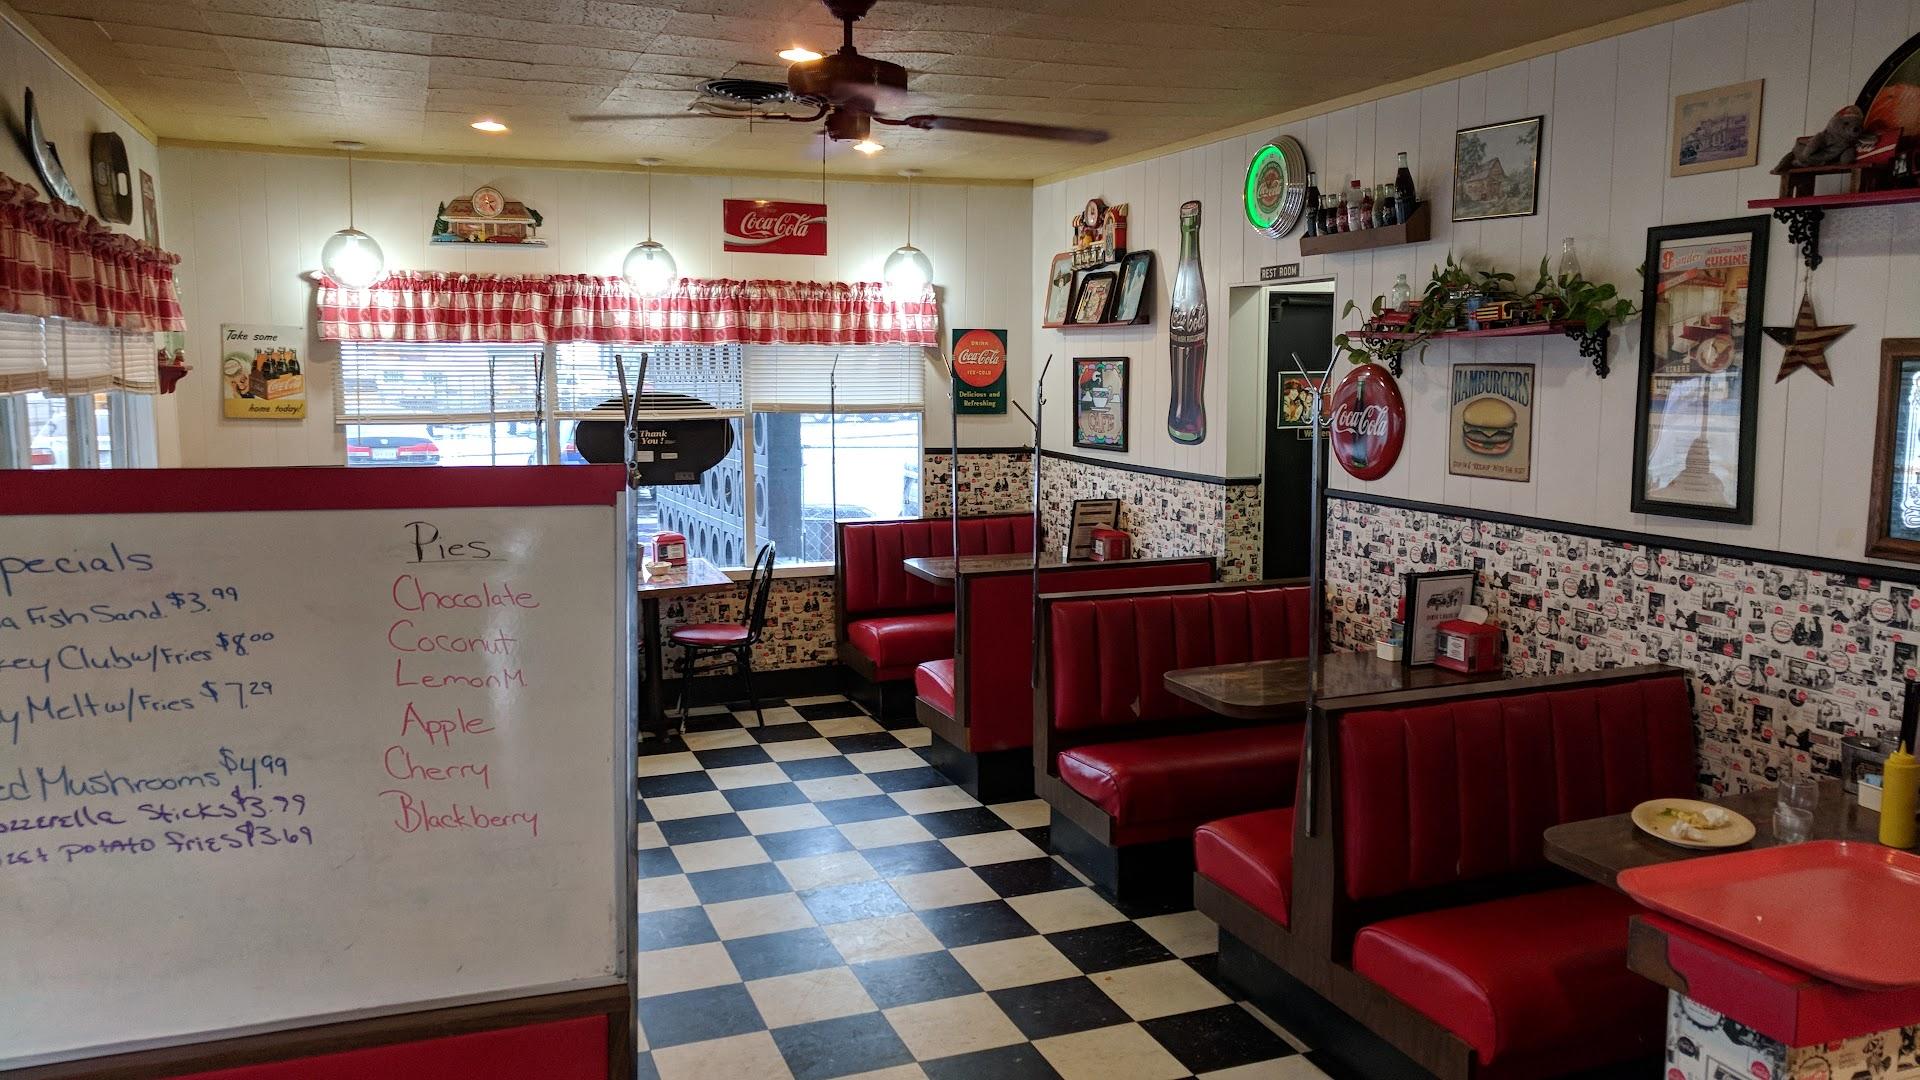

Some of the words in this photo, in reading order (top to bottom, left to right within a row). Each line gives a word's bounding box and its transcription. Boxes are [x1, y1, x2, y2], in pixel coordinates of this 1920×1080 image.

[740, 211, 811, 237] Coca-Cola
[1261, 268, 1277, 279] REST
[1279, 264, 1298, 277] ROOM
[226, 329, 249, 341] Take
[958, 348, 1001, 365] Coca-Cola
[959, 390, 987, 398] Delicious
[988, 390, 1000, 398] and
[1453, 370, 1530, 407] HAMBURGERS
[248, 404, 271, 413] home
[274, 404, 303, 414] today!
[963, 400, 997, 408] Refreshing
[1335, 403, 1389, 437] Coca-Cola
[639, 429, 668, 438] Thank
[1303, 429, 1330, 438] Woen
[404, 521, 492, 563] Pies
[0, 542, 154, 597] pecials
[393, 574, 540, 612] Chocolate
[26, 605, 89, 629] Fish
[388, 619, 518, 655] Coconut
[401, 702, 496, 747] Apple
[384, 745, 490, 790] Cherry
[36, 764, 221, 802] Mushrooms
[137, 803, 238, 824] Sticks
[378, 789, 539, 838] Blackberry
